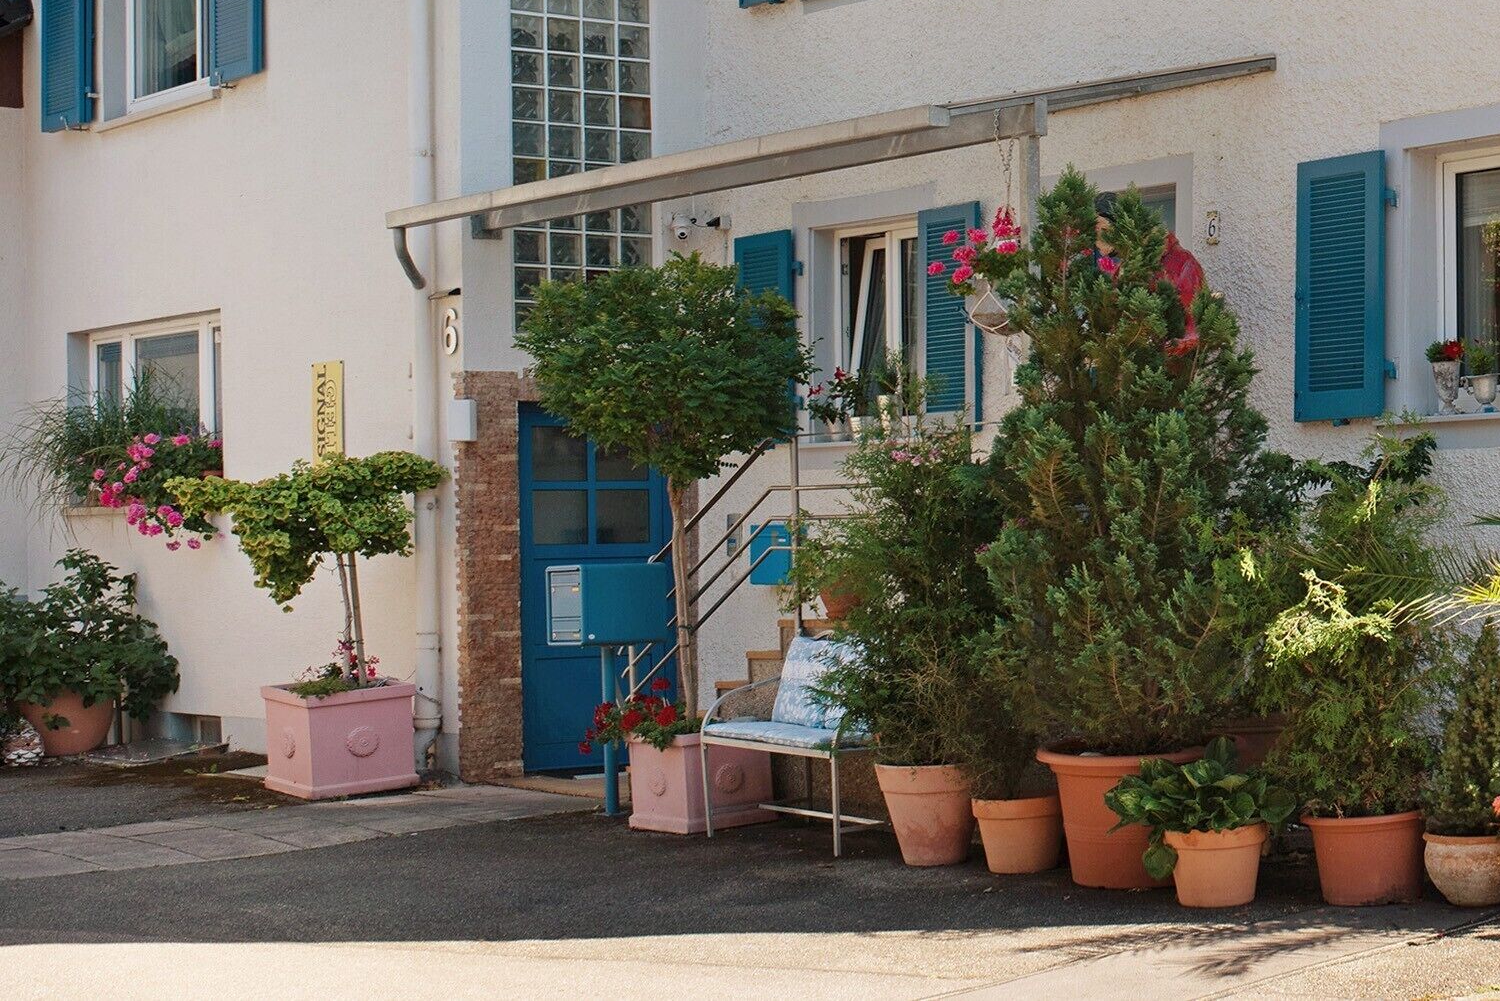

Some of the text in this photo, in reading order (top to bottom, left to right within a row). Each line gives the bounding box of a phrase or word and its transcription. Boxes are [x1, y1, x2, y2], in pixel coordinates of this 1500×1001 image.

[1208, 218, 1216, 237] 6
[443, 308, 458, 355] 6
[316, 364, 327, 458] SIGNAL
